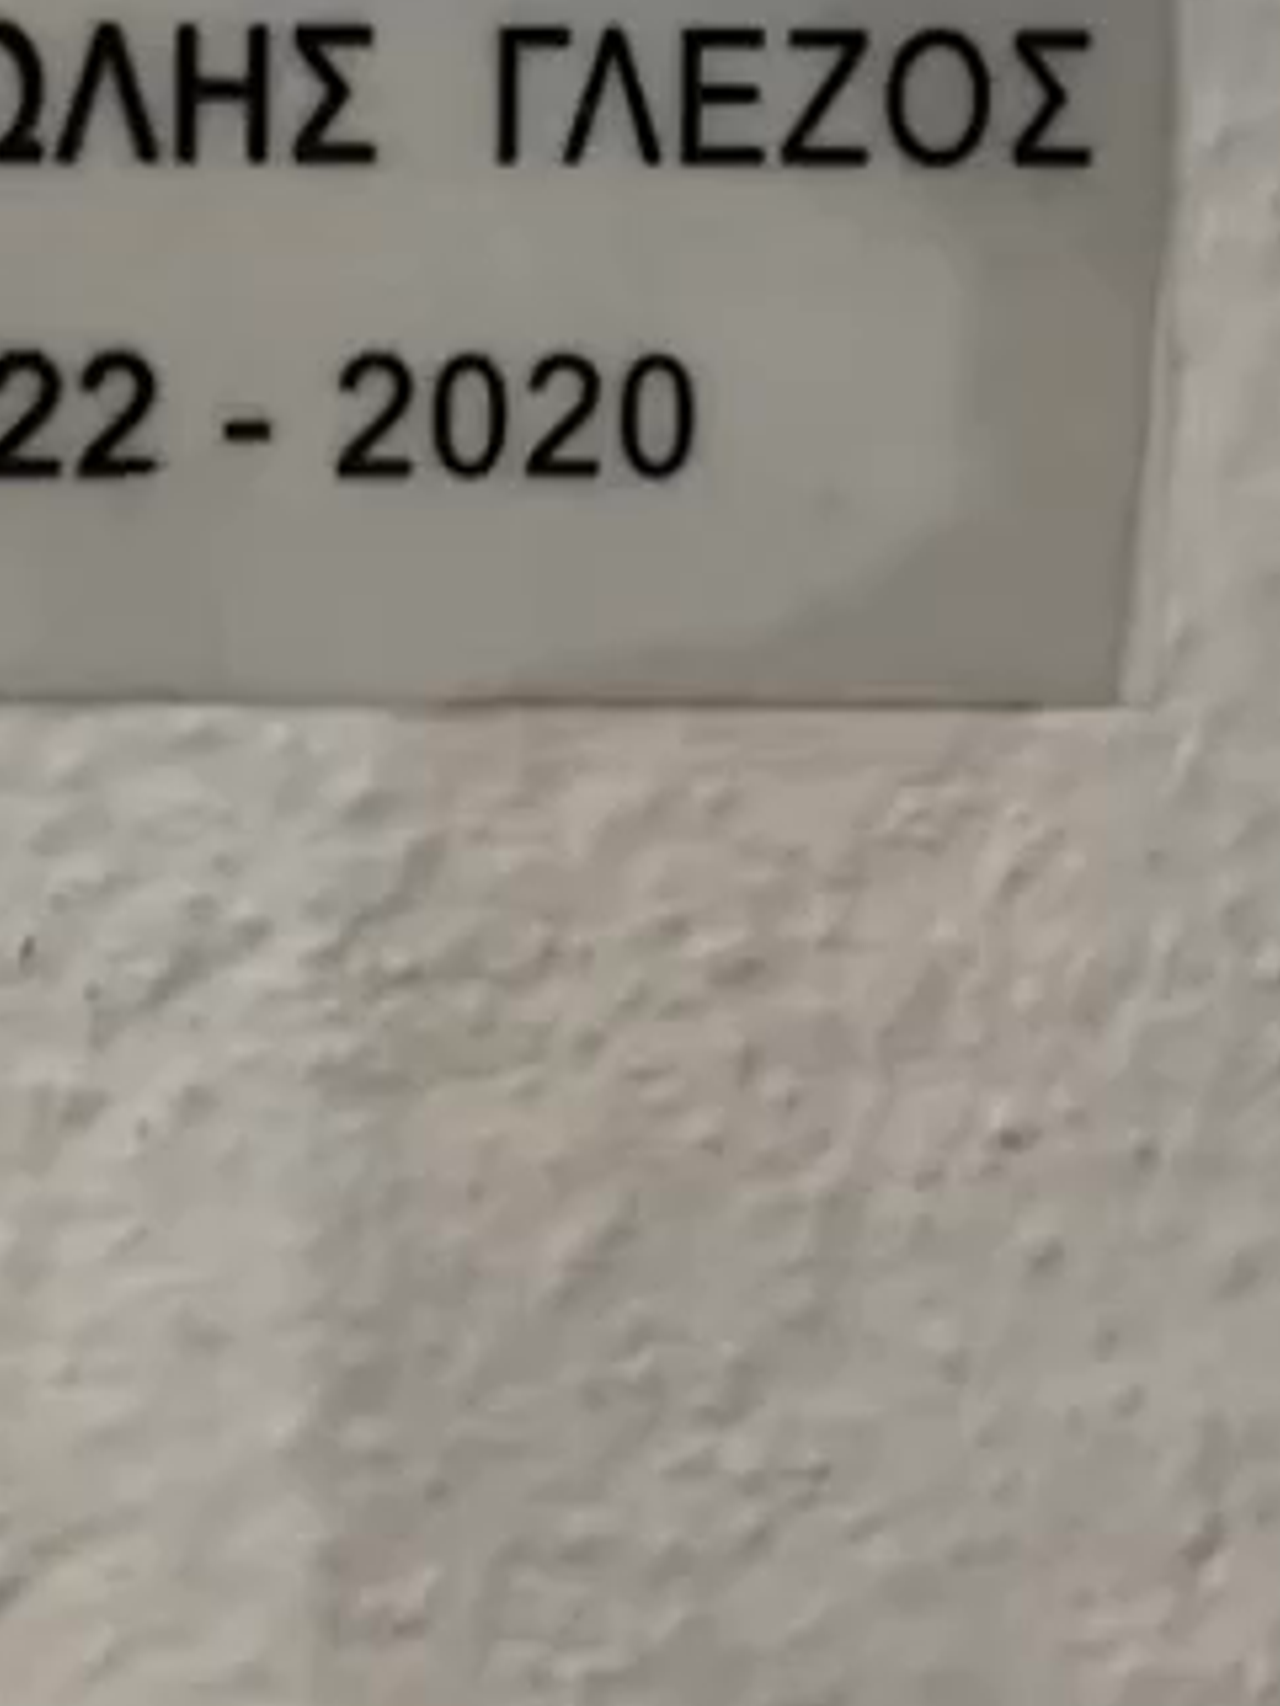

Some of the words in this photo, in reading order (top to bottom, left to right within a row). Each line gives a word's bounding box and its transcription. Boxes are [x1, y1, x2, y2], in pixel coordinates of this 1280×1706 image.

[494, 22, 1096, 173] ΓΛΕΖΟΣ
[220, 416, 274, 446] -
[332, 348, 698, 484] 2020
